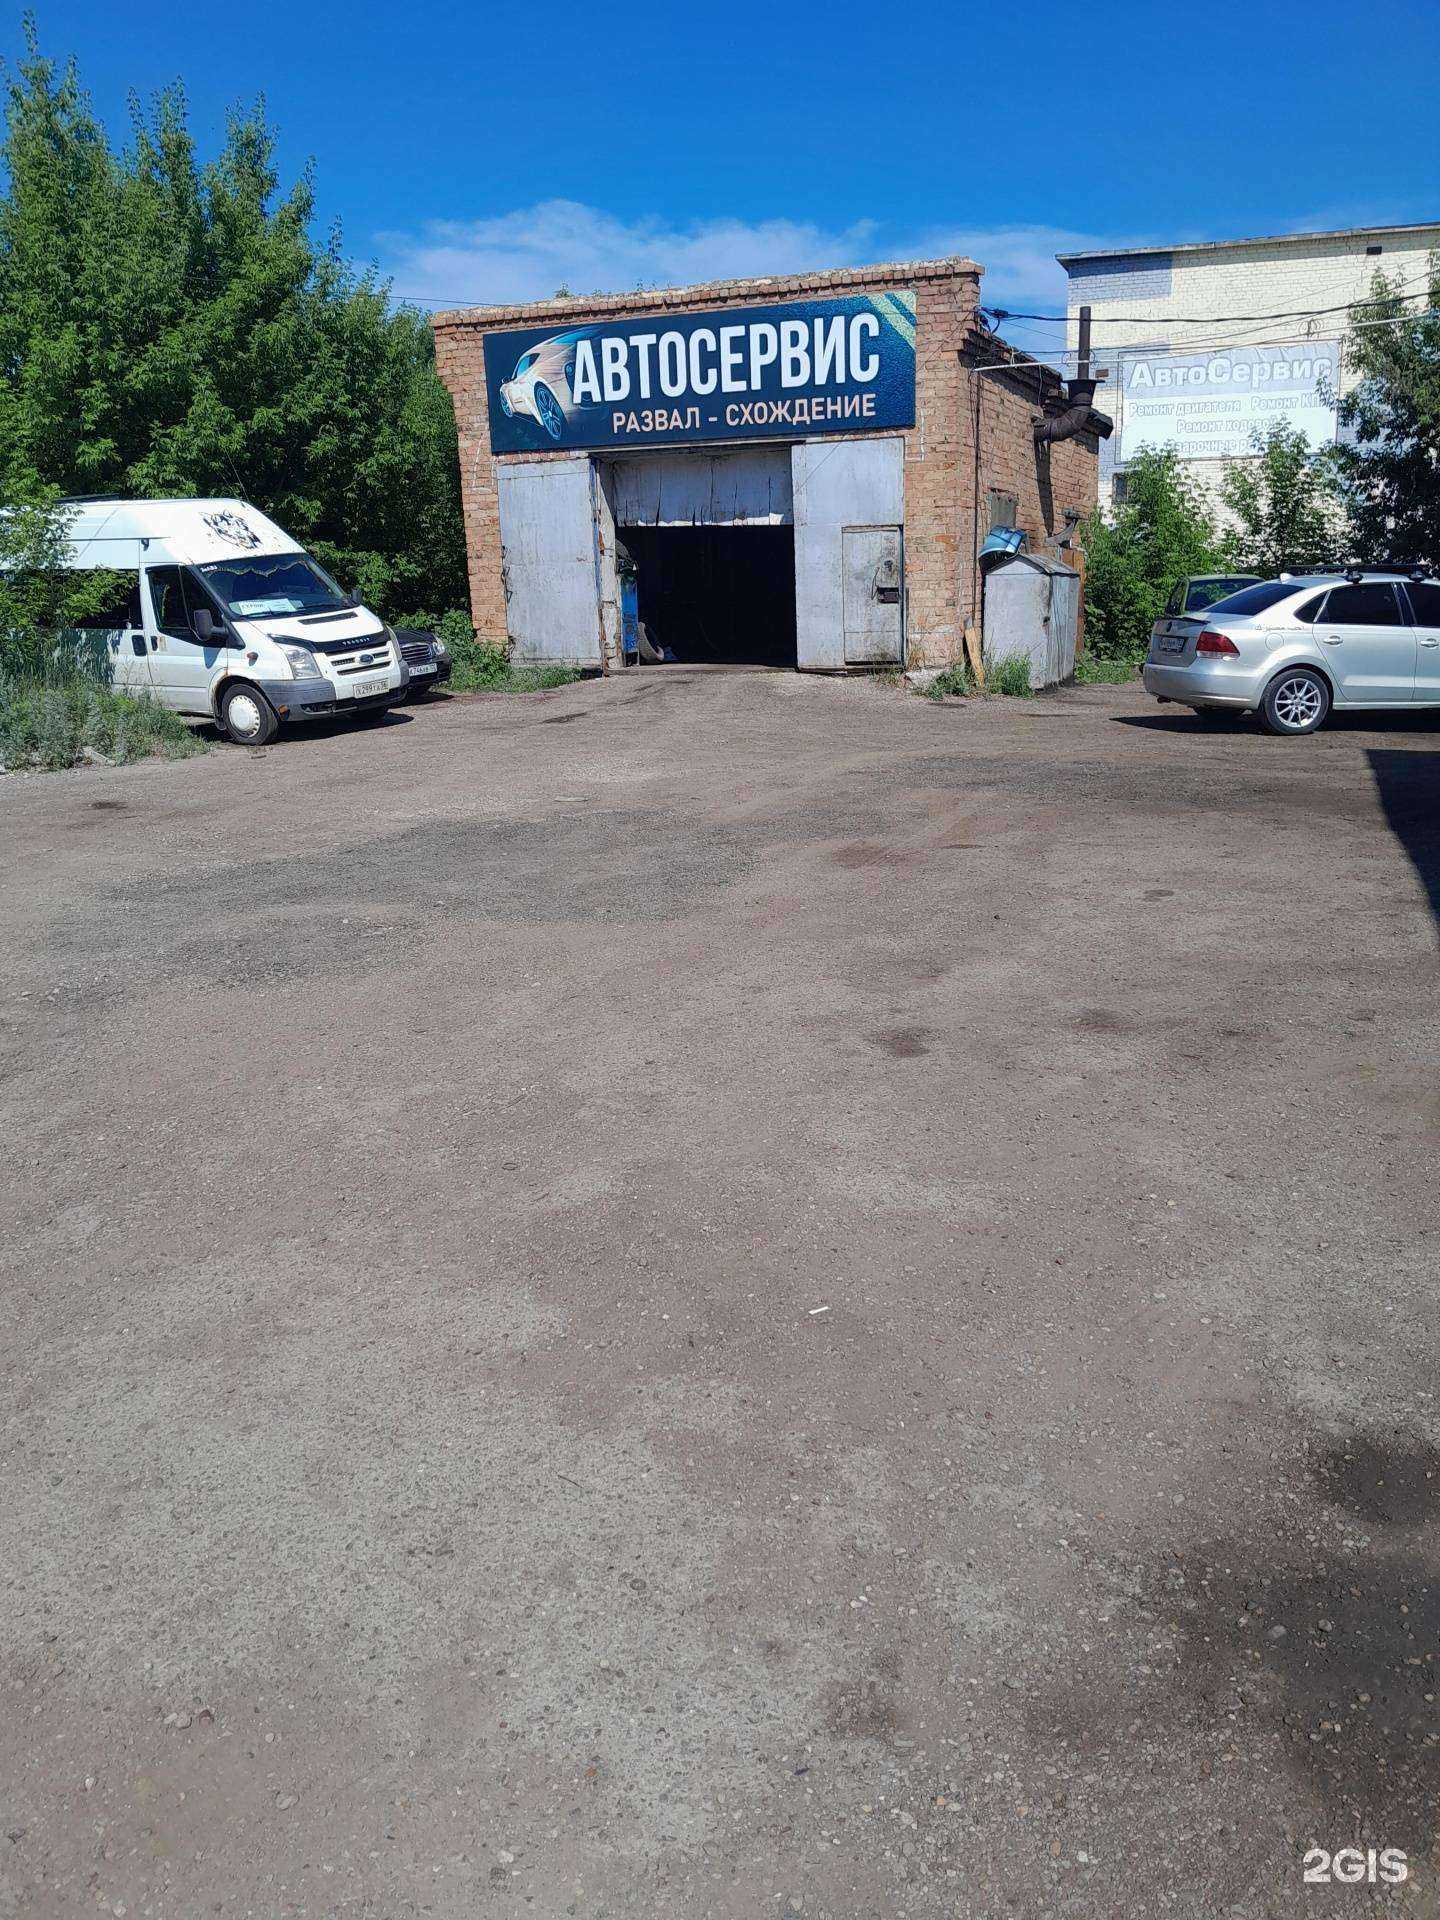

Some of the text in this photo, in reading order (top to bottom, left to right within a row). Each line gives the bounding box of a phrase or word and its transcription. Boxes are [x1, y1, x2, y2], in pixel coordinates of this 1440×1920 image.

[573, 312, 880, 405] АВТОСЕРВИС
[1129, 357, 1333, 389] АвтоСервис
[612, 406, 700, 434] РАЗВАЛ
[726, 393, 877, 426] СХОЖДЕНИЕ
[1129, 402, 1174, 417] Ремонт
[1176, 400, 1241, 416] двигателя
[1251, 395, 1298, 410] Ремонт
[1177, 419, 1222, 433] Ремонт
